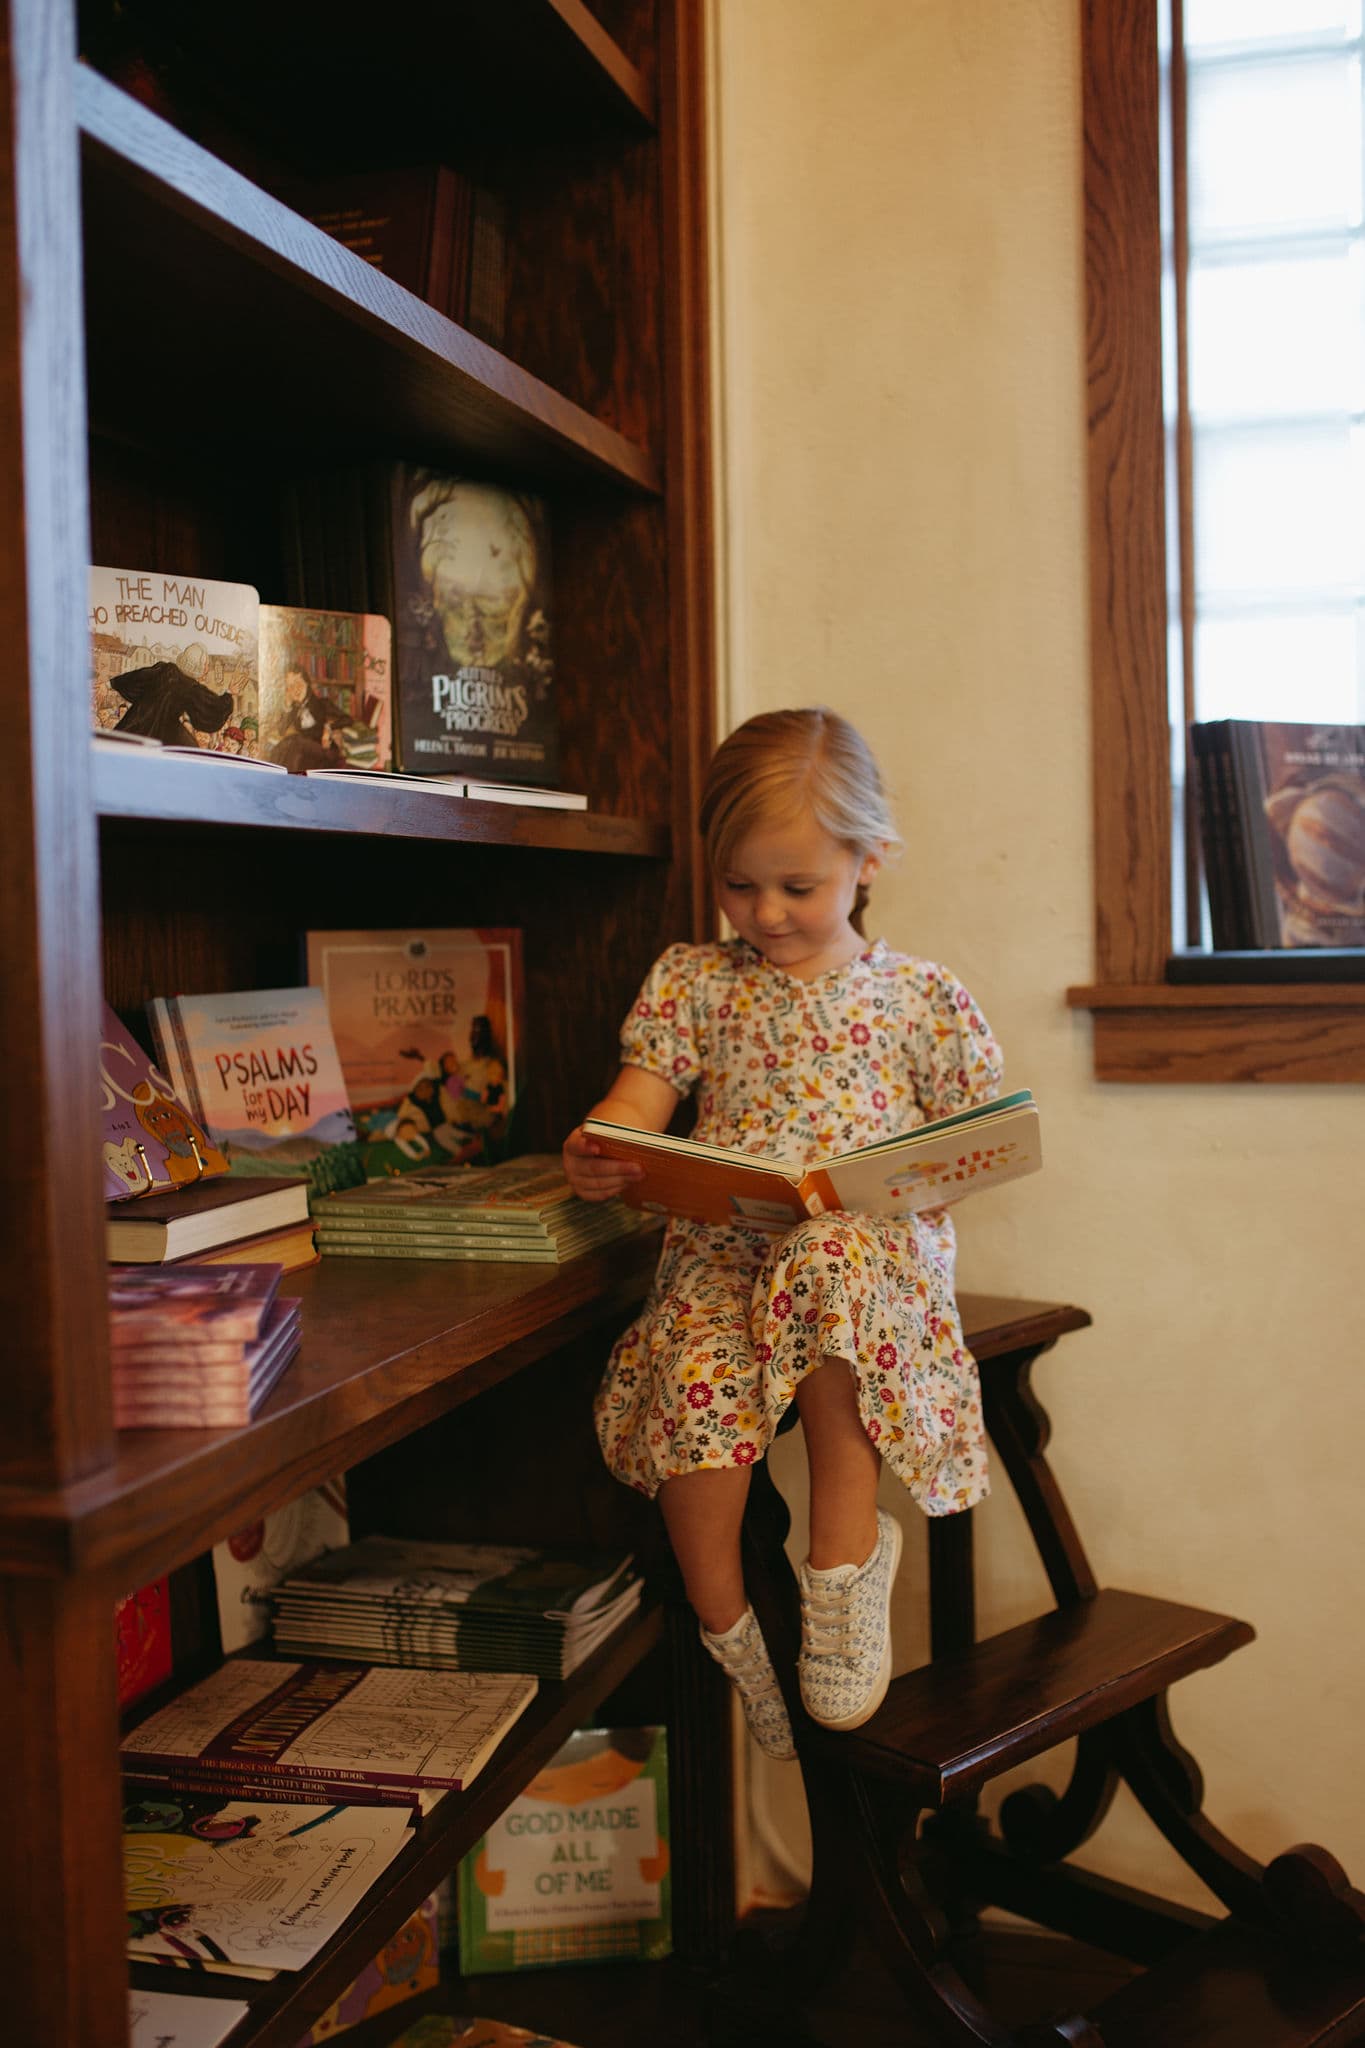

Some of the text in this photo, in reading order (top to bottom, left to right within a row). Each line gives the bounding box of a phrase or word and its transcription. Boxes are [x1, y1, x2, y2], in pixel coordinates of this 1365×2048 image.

[115, 577, 205, 610] THE MAN
[88, 605, 244, 646] HO PREACHED OUTSIDE
[373, 992, 458, 1016] PRAYER
[215, 1044, 318, 1091] PSALMS
[242, 1088, 263, 1106] for
[246, 1082, 310, 1125] my DAY
[201, 1760, 218, 1768] THE
[220, 1760, 255, 1772] BIGGEST
[256, 1764, 286, 1774] STORY
[298, 1767, 338, 1778] ACTIVITY
[340, 1770, 365, 1780] BOOK
[262, 1777, 300, 1789] ACTIVITY
[302, 1781, 326, 1792] BOOK
[264, 1792, 303, 1802] ACTIVITY
[304, 1795, 328, 1804] BOOK
[506, 1807, 640, 1836] GOD MADE
[552, 1841, 598, 1862] ALL
[535, 1869, 614, 1896] OF ME
